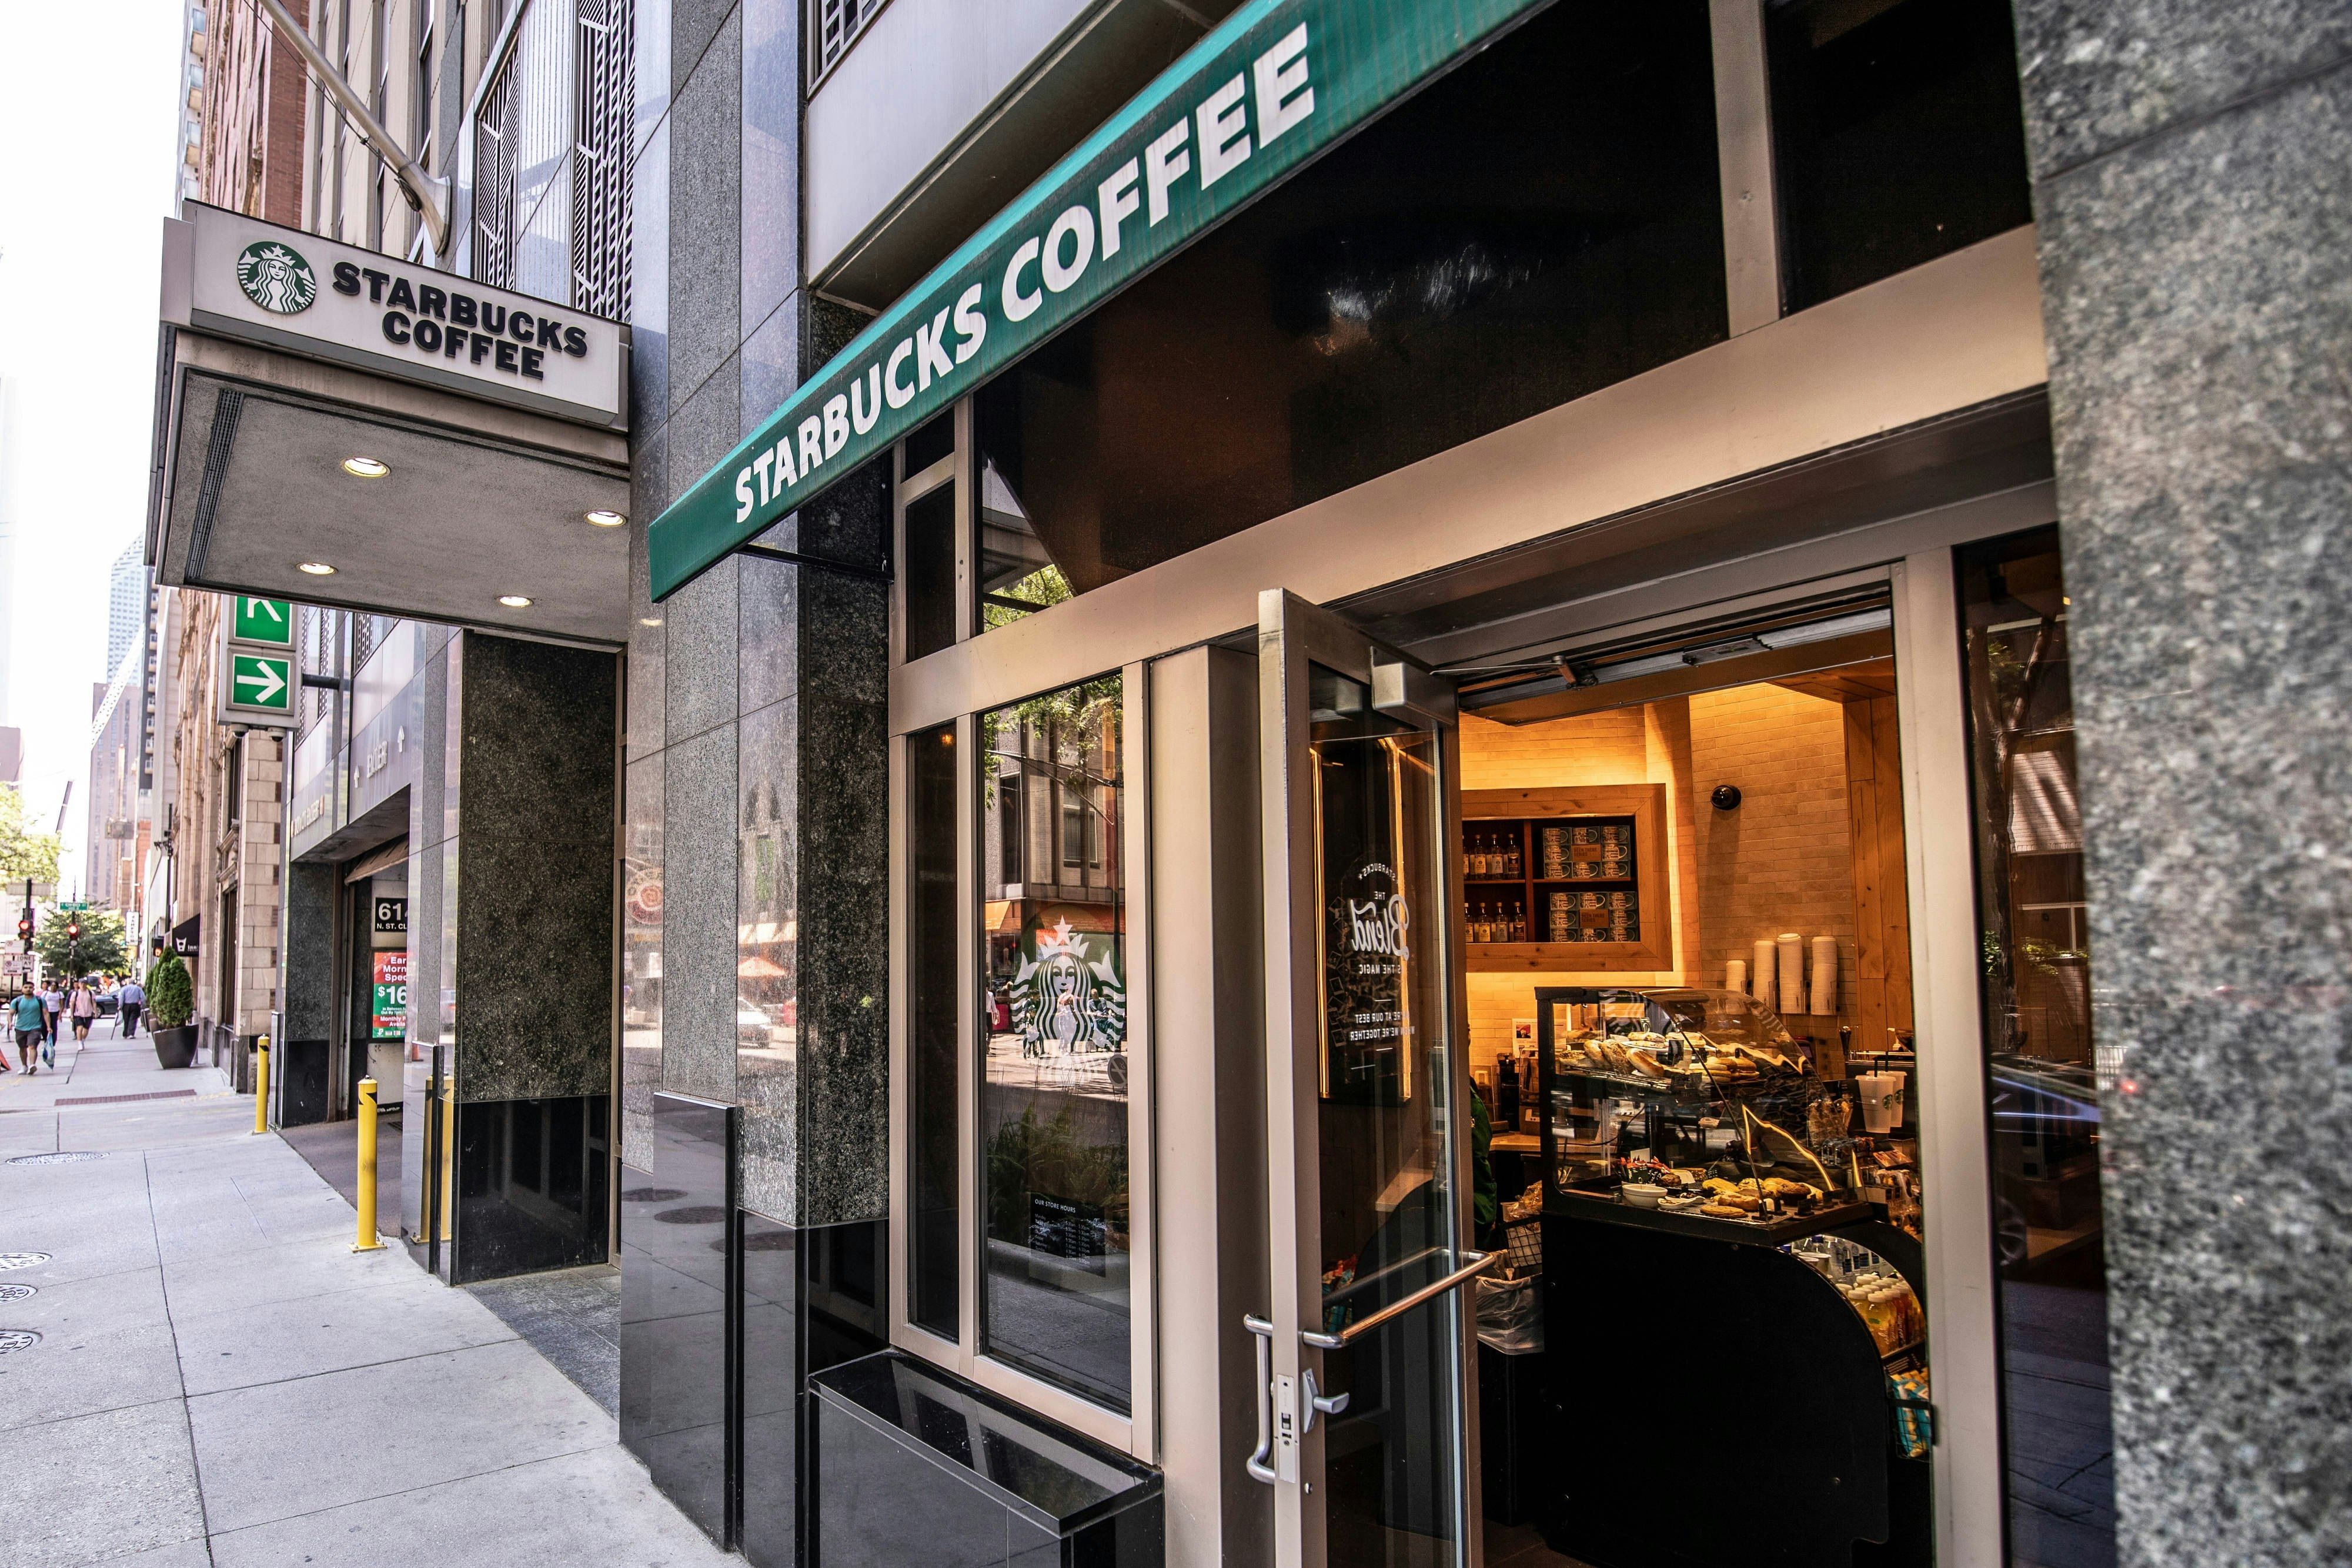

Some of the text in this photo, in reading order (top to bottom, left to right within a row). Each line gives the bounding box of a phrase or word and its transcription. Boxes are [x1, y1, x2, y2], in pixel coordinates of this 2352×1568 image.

[332, 262, 588, 357] STARBUCKS
[736, 22, 1314, 523] STARBUCKS COFFEE
[382, 311, 544, 380] COFFEE
[1045, 1201, 1059, 1209] STORE
[1060, 1205, 1076, 1213] HOURS
